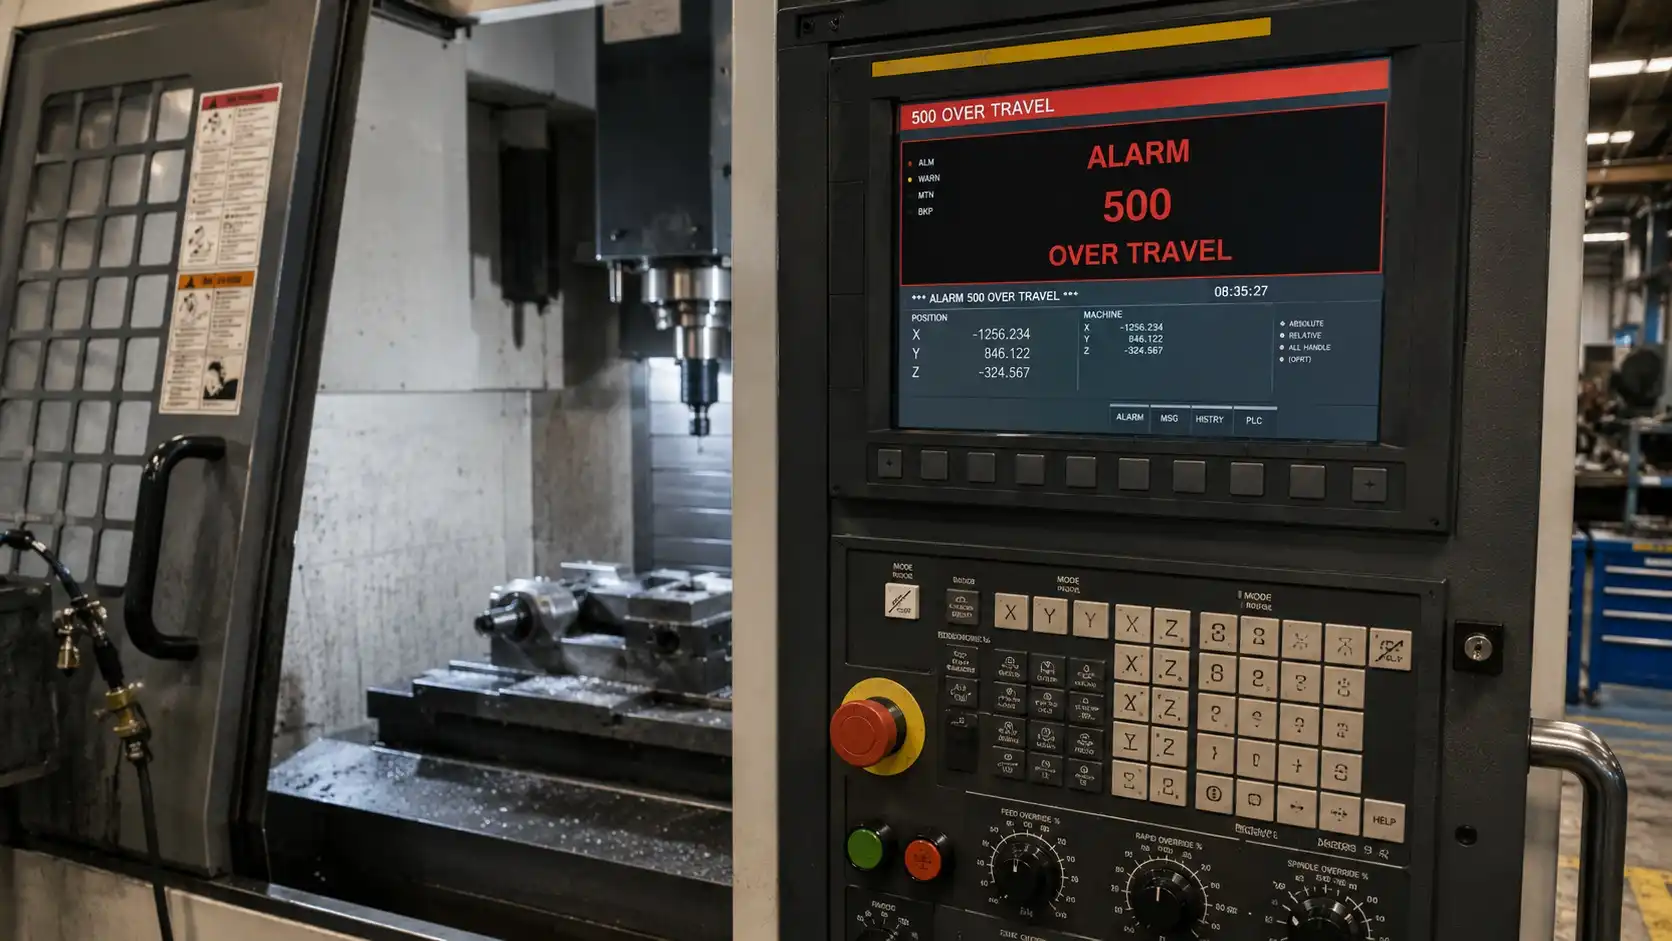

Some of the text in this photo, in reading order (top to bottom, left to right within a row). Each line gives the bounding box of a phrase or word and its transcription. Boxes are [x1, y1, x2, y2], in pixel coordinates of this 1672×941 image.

[912, 98, 1054, 124] 500 OVER TRAVEL
[1087, 138, 1190, 170] ALARM
[918, 158, 934, 167] ALM
[918, 174, 940, 183] WARN
[918, 191, 934, 199] MTN
[1103, 187, 1172, 223] 500
[918, 207, 933, 216] BKP
[1048, 238, 1232, 267] OVER TRAVEL
[929, 290, 1060, 303] ALARM 500 OVER TRAVEL
[1214, 285, 1268, 297] 08:35:27
[911, 313, 948, 322] POSITION
[1083, 310, 1123, 319] MACHINE
[1084, 323, 1163, 331] X -1256.234
[912, 328, 1031, 341] X -1256.234
[1084, 335, 1164, 343] Y 846.122
[1288, 331, 1322, 339] RELATIVE
[912, 347, 1030, 359] Y 846.122
[1084, 346, 1164, 355] Z -324.567
[912, 366, 1030, 378] Z -324.567
[1116, 413, 1144, 421] ALARM
[1160, 414, 1179, 422] MSG
[1195, 415, 1224, 423] HISTRY
[1246, 416, 1263, 425] PLC
[1005, 604, 1017, 620] X
[1044, 607, 1056, 623] Y
[1084, 611, 1096, 628] Y
[1126, 615, 1138, 633] X
[1165, 619, 1178, 638] Z
[1125, 654, 1138, 672] X
[1164, 659, 1177, 677] Z
[1164, 699, 1176, 717] Z
[1373, 815, 1397, 827] HELP
